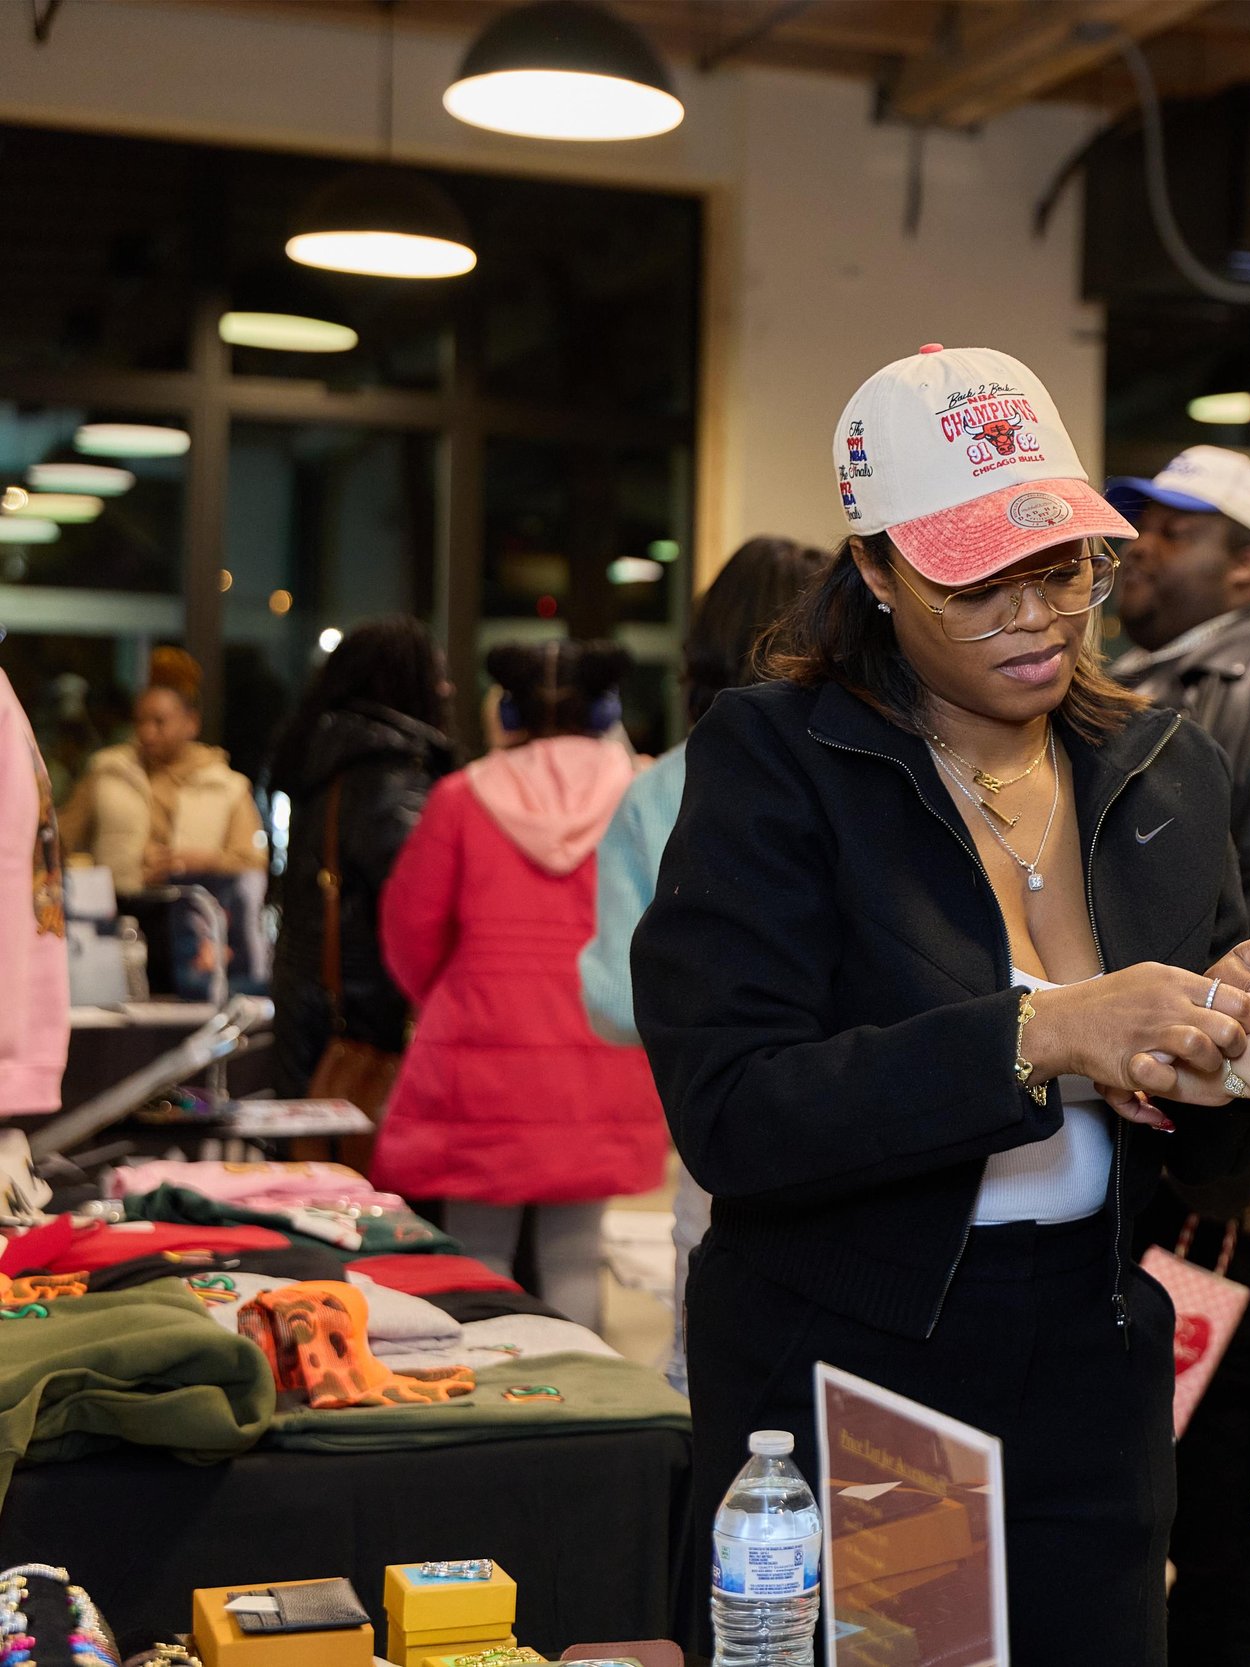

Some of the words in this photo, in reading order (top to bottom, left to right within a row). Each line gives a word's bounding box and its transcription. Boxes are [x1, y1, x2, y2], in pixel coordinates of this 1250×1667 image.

[978, 384, 986, 395] 2
[967, 394, 997, 404] NBA
[849, 420, 864, 437] The
[941, 399, 1038, 443] CHAMPIONS
[847, 436, 864, 450] 1991
[1016, 433, 1040, 452] 92
[850, 449, 867, 462] NBA
[967, 442, 993, 465] 91
[973, 457, 1016, 477] CHICAGO
[1019, 454, 1045, 463] BULLS
